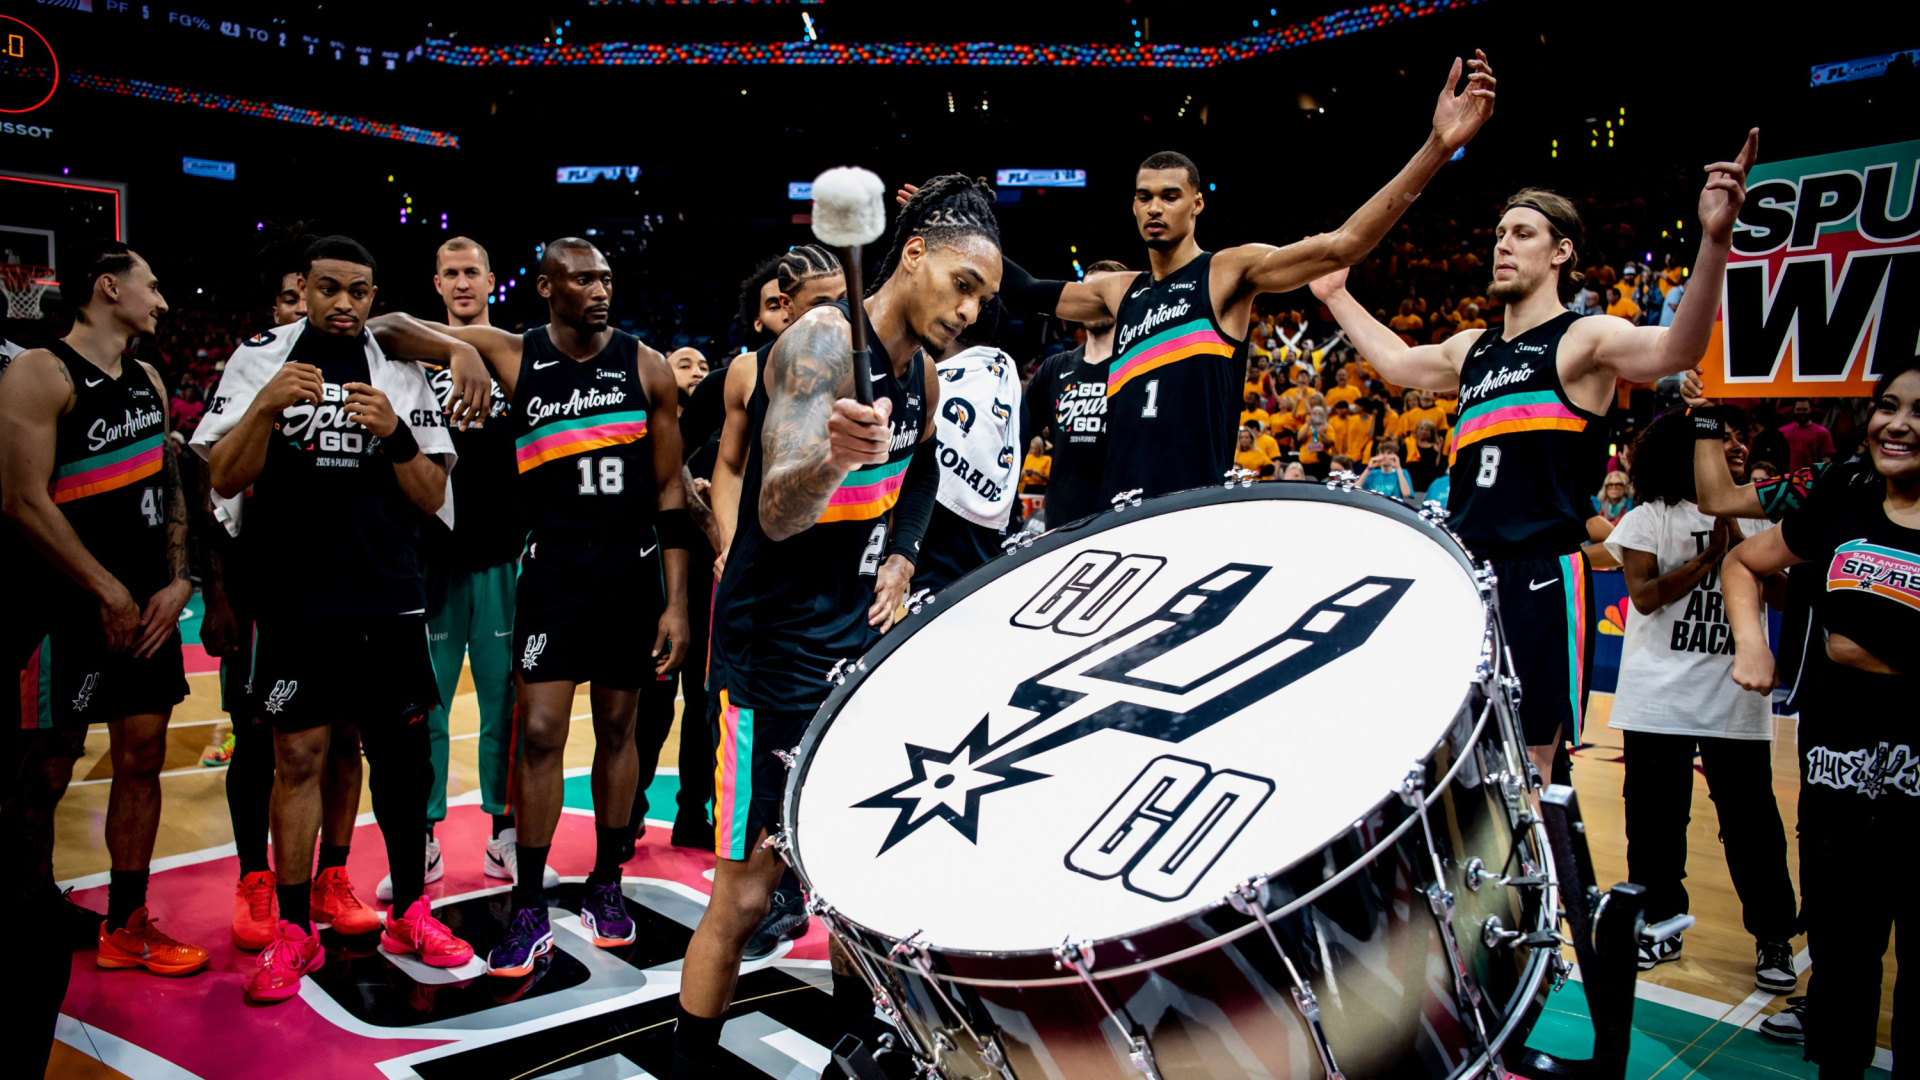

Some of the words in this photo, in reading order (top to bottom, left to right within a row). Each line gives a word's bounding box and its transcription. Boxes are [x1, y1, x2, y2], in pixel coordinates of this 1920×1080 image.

[168, 12, 211, 31] FG%
[246, 27, 269, 42] TO
[278, 32, 287, 47] 2
[1118, 324, 1137, 354] San
[1138, 298, 1191, 336] Antonio
[600, 371, 622, 379] LEDGER
[1078, 382, 1106, 397] GO
[1473, 362, 1534, 398] Antonio
[527, 396, 561, 426] San
[562, 386, 626, 415] Antonio
[1141, 380, 1159, 418] 1
[87, 418, 122, 451] San
[122, 405, 162, 437] Antonio
[319, 430, 362, 453] GO
[1073, 416, 1101, 432] GO
[577, 457, 624, 495] 18
[1476, 445, 1501, 487] 8
[859, 524, 888, 575] 2
[1853, 552, 1875, 562] SAN
[1009, 549, 1167, 637] GO
[428, 632, 448, 641] URS
[1064, 754, 1276, 902] GO
